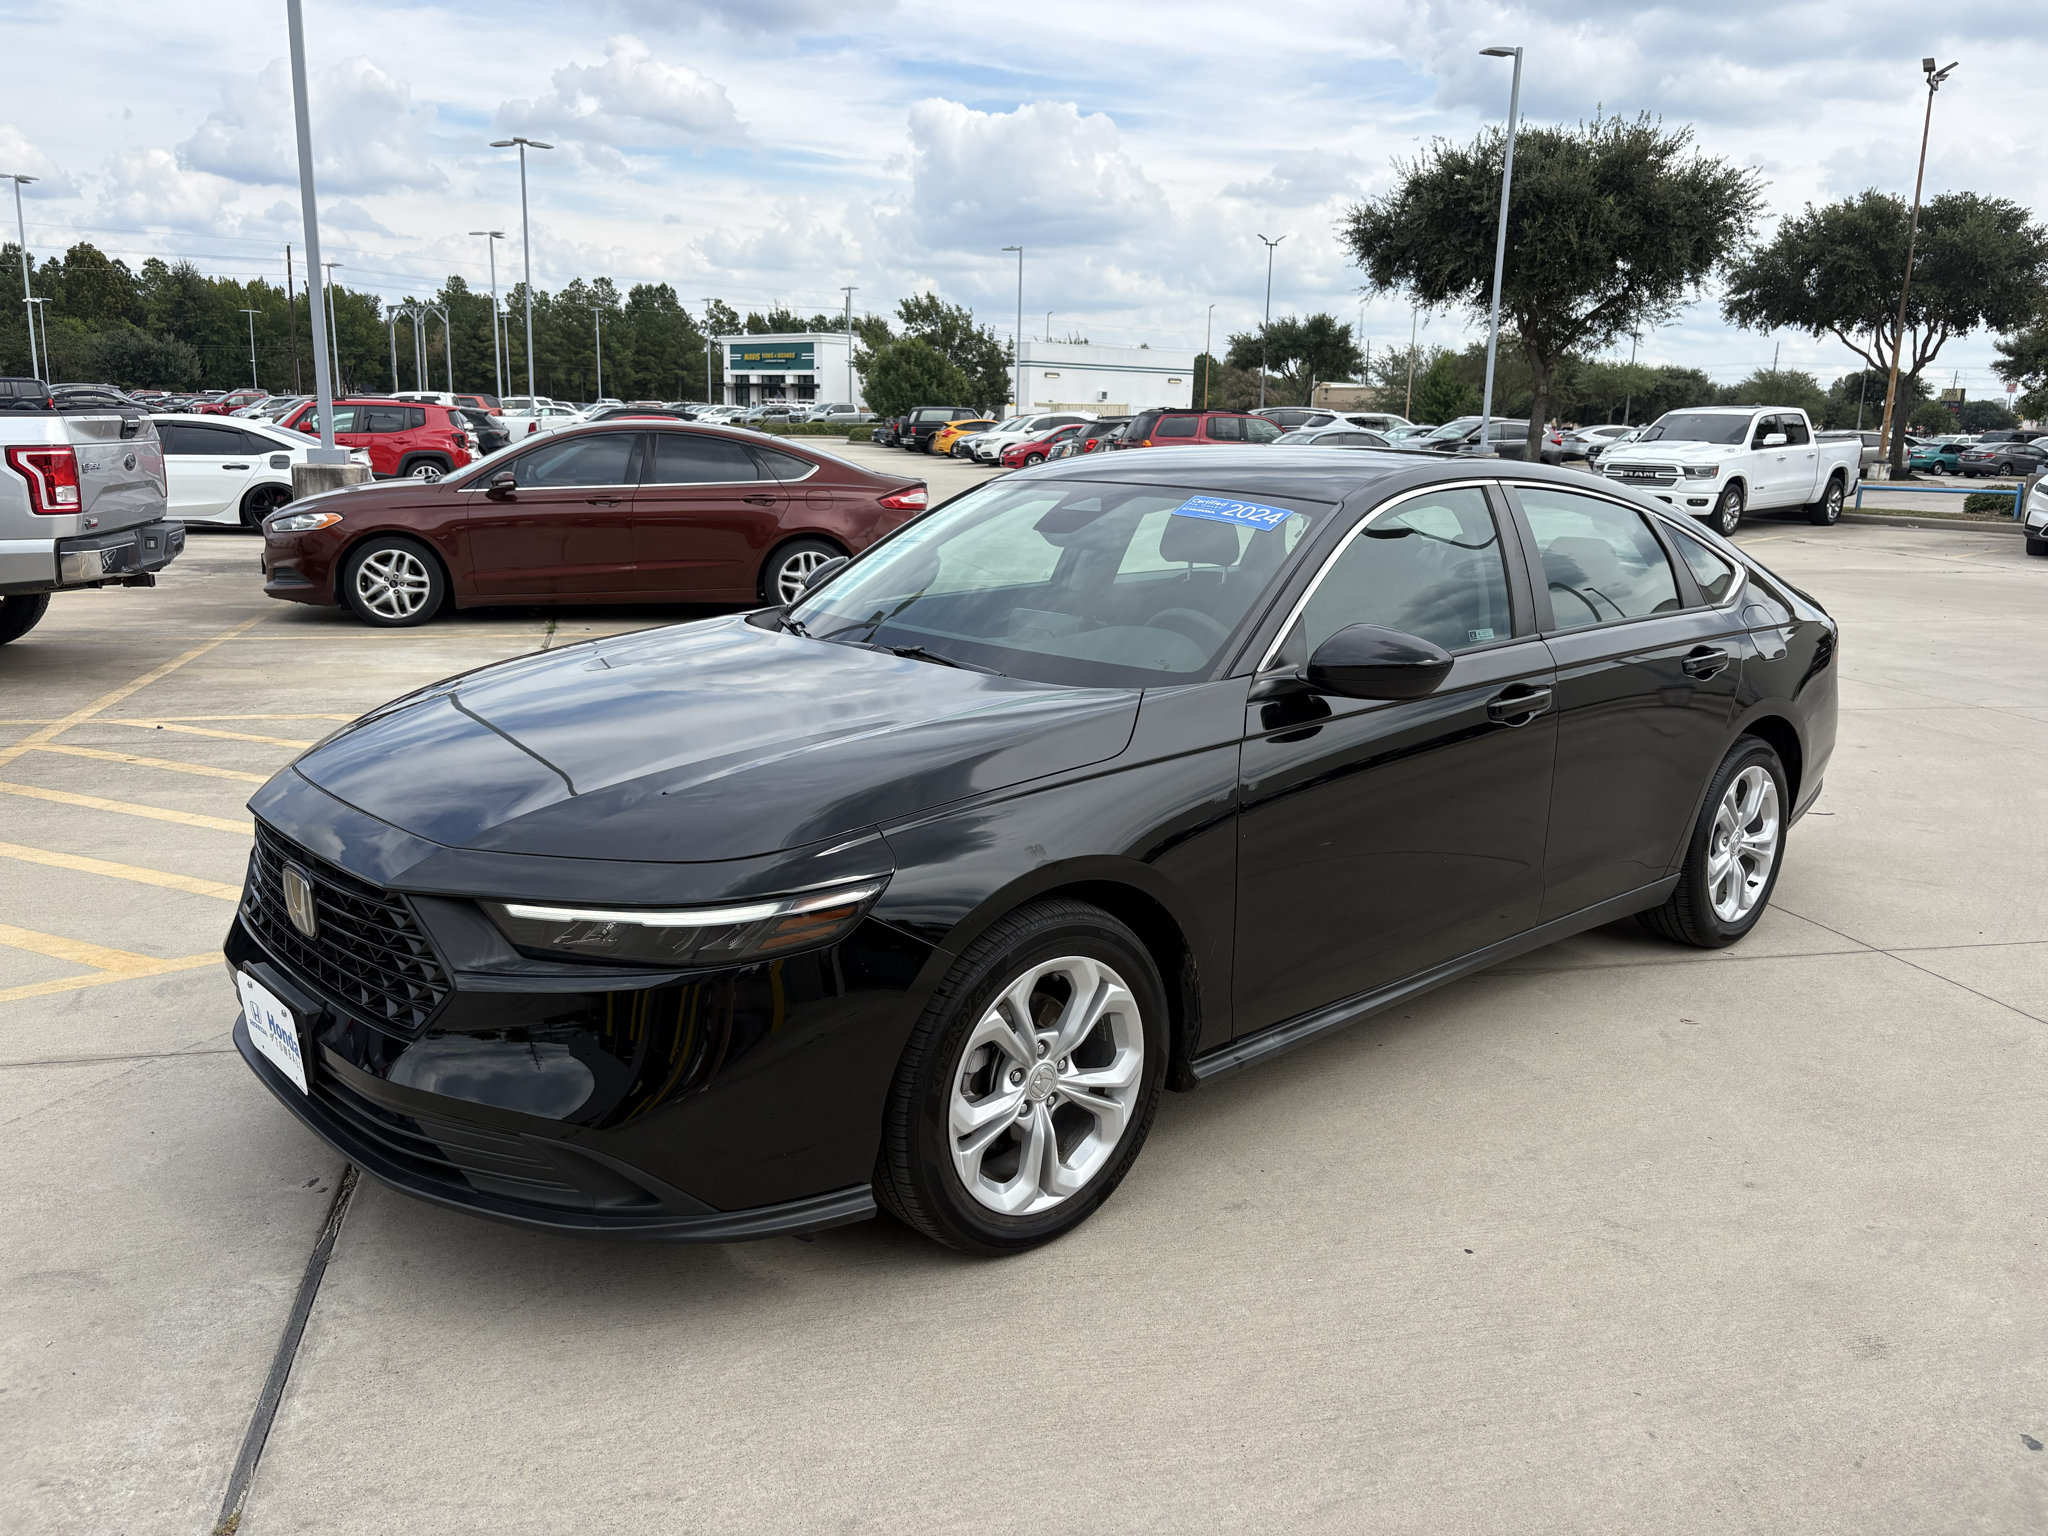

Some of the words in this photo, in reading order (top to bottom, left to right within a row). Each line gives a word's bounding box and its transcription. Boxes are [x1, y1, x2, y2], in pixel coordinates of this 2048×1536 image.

[1192, 498, 1229, 507] Certified
[1220, 504, 1284, 525] 2024
[249, 1018, 269, 1038] HONDA
[266, 1010, 301, 1060] Honda
